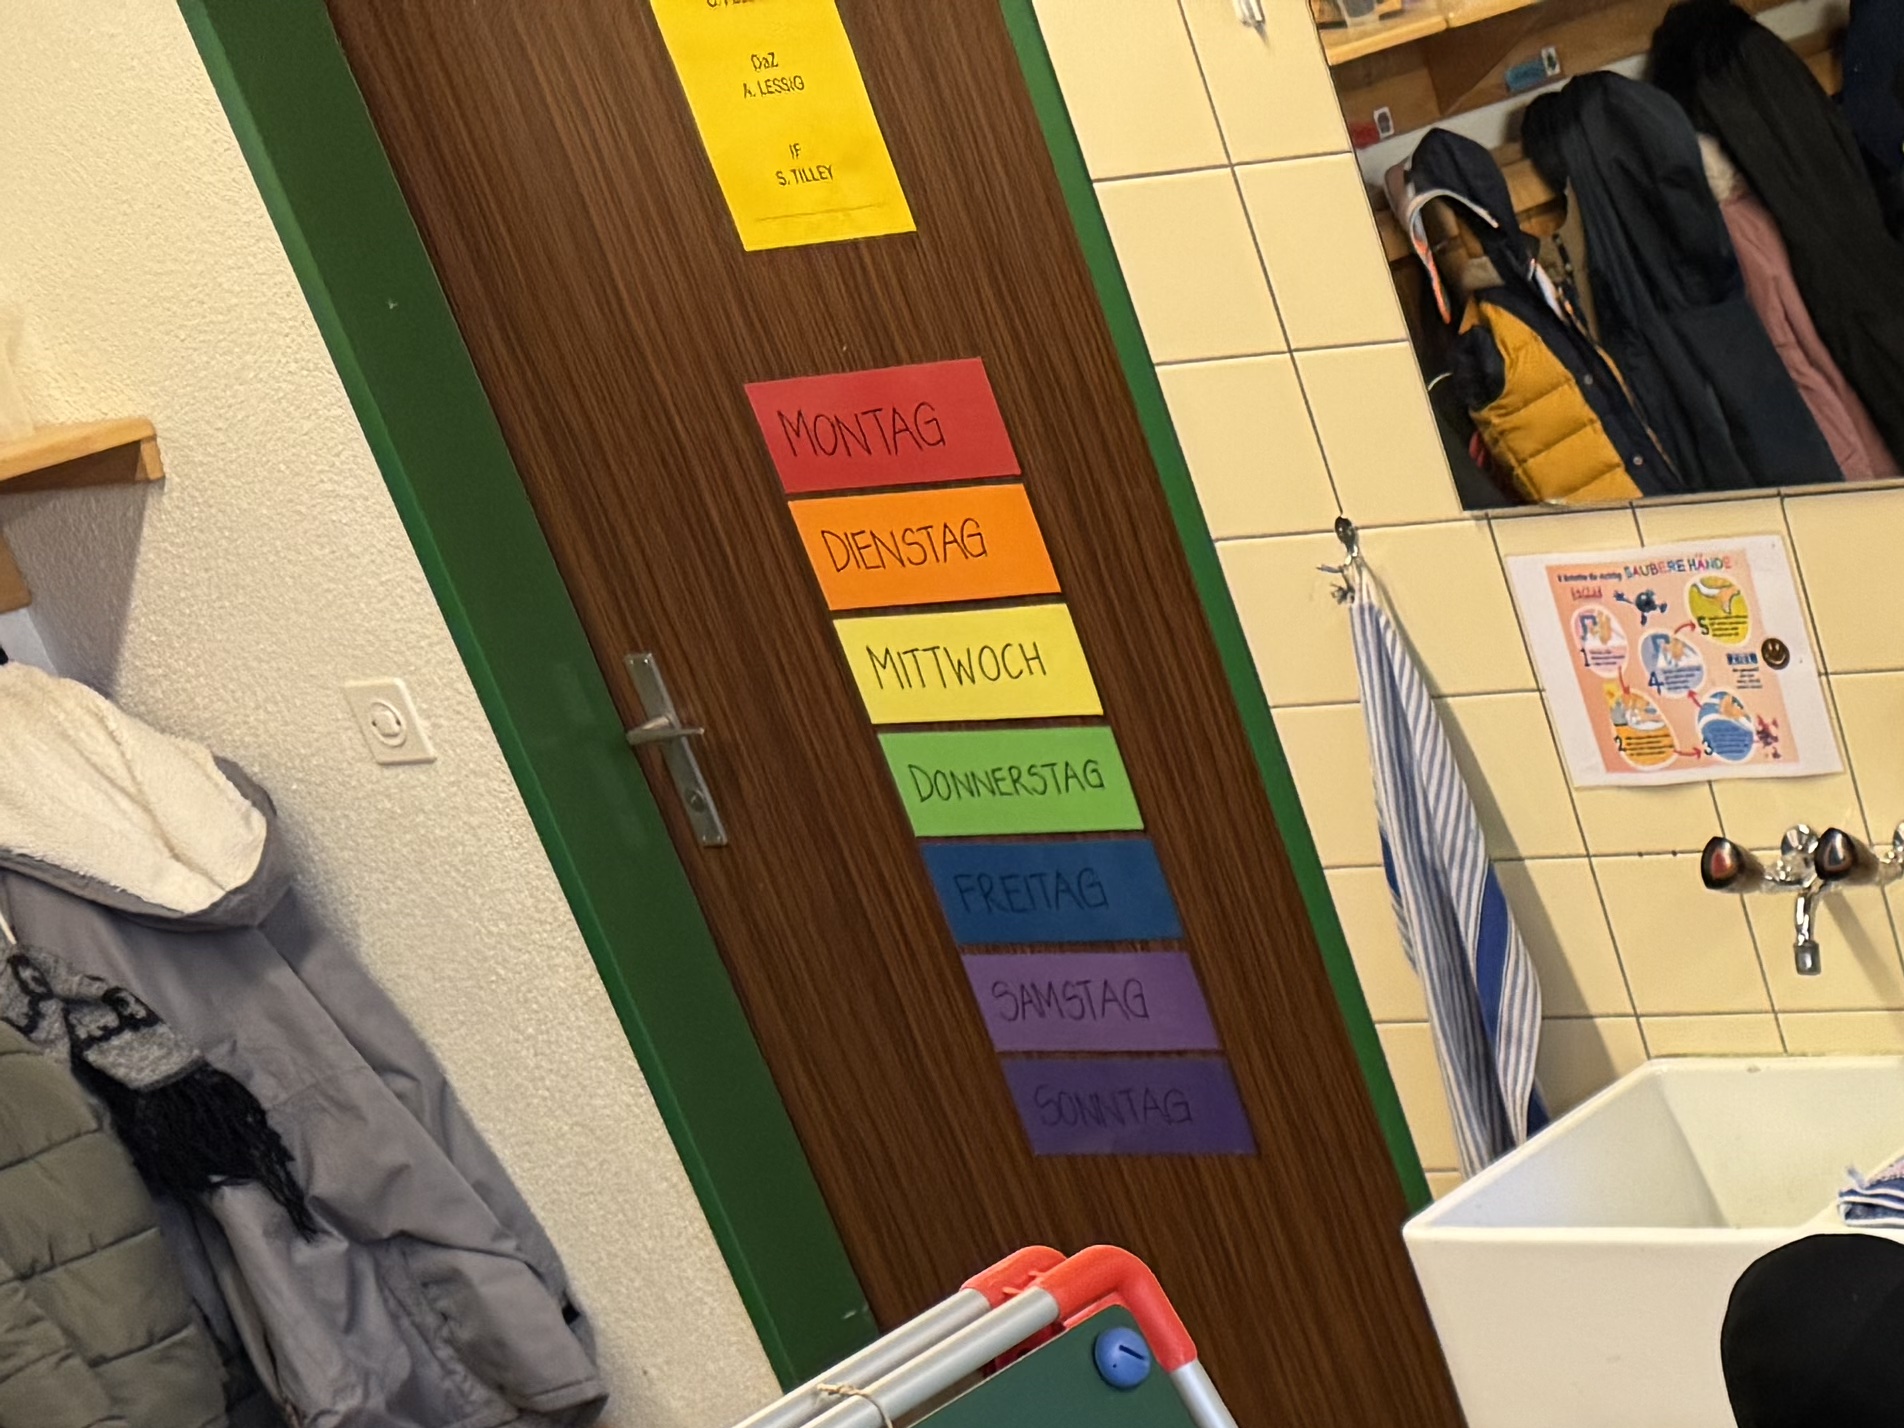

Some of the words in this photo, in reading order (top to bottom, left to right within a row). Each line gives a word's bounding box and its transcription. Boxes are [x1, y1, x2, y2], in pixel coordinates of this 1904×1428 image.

[757, 75, 805, 96] LESSIG
[791, 165, 833, 184] TILLEY
[777, 402, 945, 458] MONTAG
[820, 517, 988, 573] DIENSTAG
[1624, 559, 1685, 578] SAUBERE
[1687, 553, 1732, 572] HÄNDE
[1697, 616, 1709, 635] 5
[866, 640, 1048, 690] MITTWOCH
[1580, 648, 1590, 667] 1
[1648, 671, 1664, 695] 4
[908, 758, 1105, 802] DONNERSTAG
[953, 866, 1109, 914] FREITAG
[991, 977, 1149, 1021] SAMSTAG
[1034, 1084, 1194, 1127] SONNTAG
